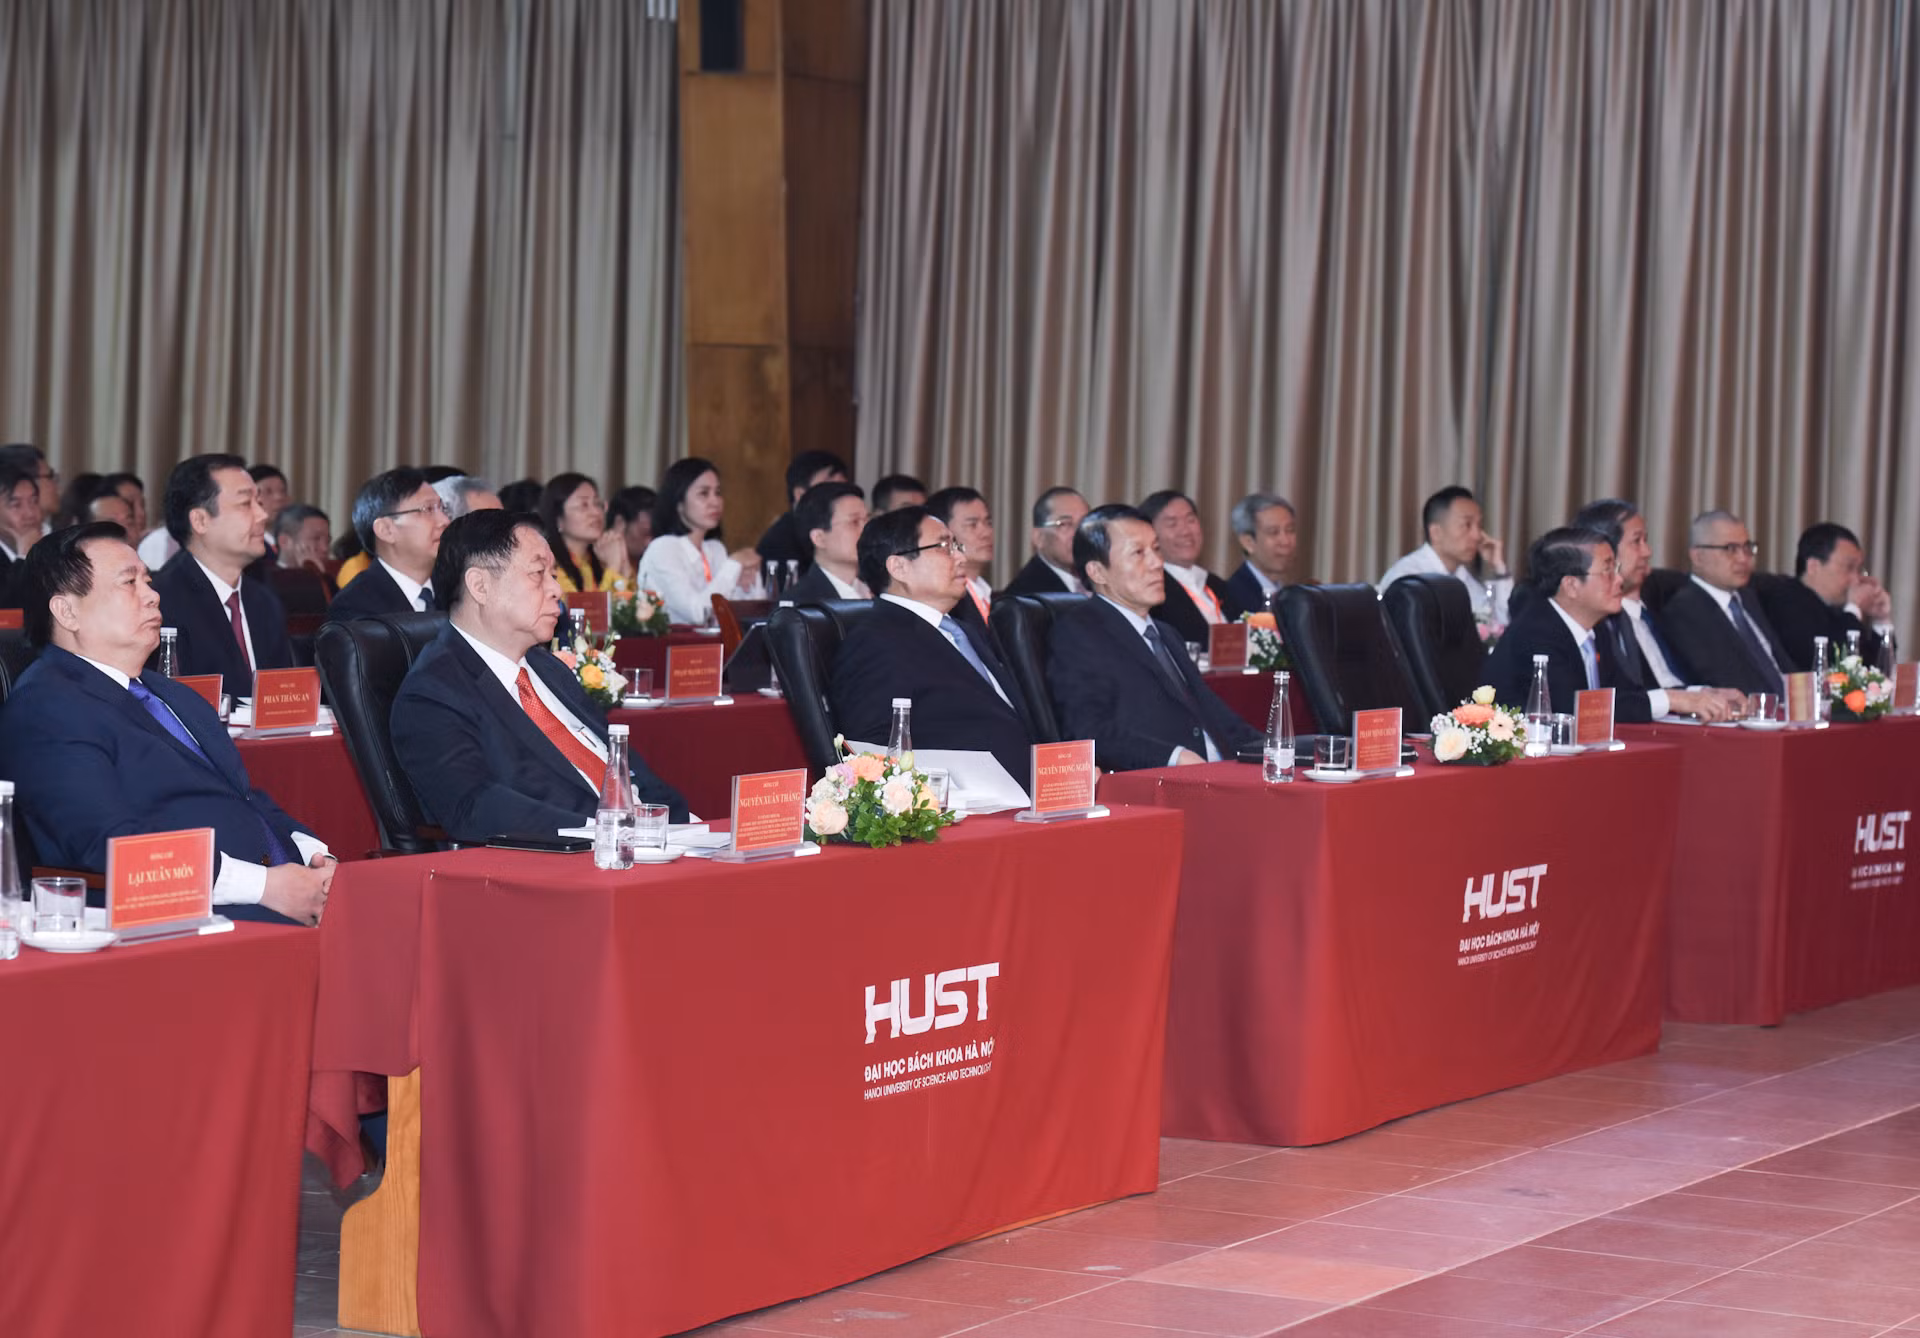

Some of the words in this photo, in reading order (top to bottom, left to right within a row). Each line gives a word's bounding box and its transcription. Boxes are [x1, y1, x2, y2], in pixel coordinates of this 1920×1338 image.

[763, 791, 780, 805] XUÂN
[1854, 810, 1912, 855] HUST
[128, 871, 144, 888] LẠI
[145, 865, 171, 883] XUÂN
[1462, 863, 1548, 923] HUST
[1459, 938, 1471, 954] ĐẠI
[1470, 934, 1486, 952] HỌC
[1485, 930, 1502, 948] BÁCH
[1502, 927, 1520, 945] KHOA
[865, 961, 1000, 1045] HUST
[864, 1063, 882, 1084] ĐẠI
[883, 1058, 906, 1080] HỌC
[907, 1051, 934, 1073] BÁCH
[935, 1046, 964, 1067] KHOA
[964, 1039, 979, 1060] HÀ
[864, 1086, 883, 1101] HANOI
[882, 1079, 914, 1097] UNIVERSITY
[912, 1077, 922, 1089] OF
[921, 1071, 946, 1088] SCIENCE
[946, 1068, 959, 1082] AND
[959, 1061, 993, 1079] TECHNOLOGY
